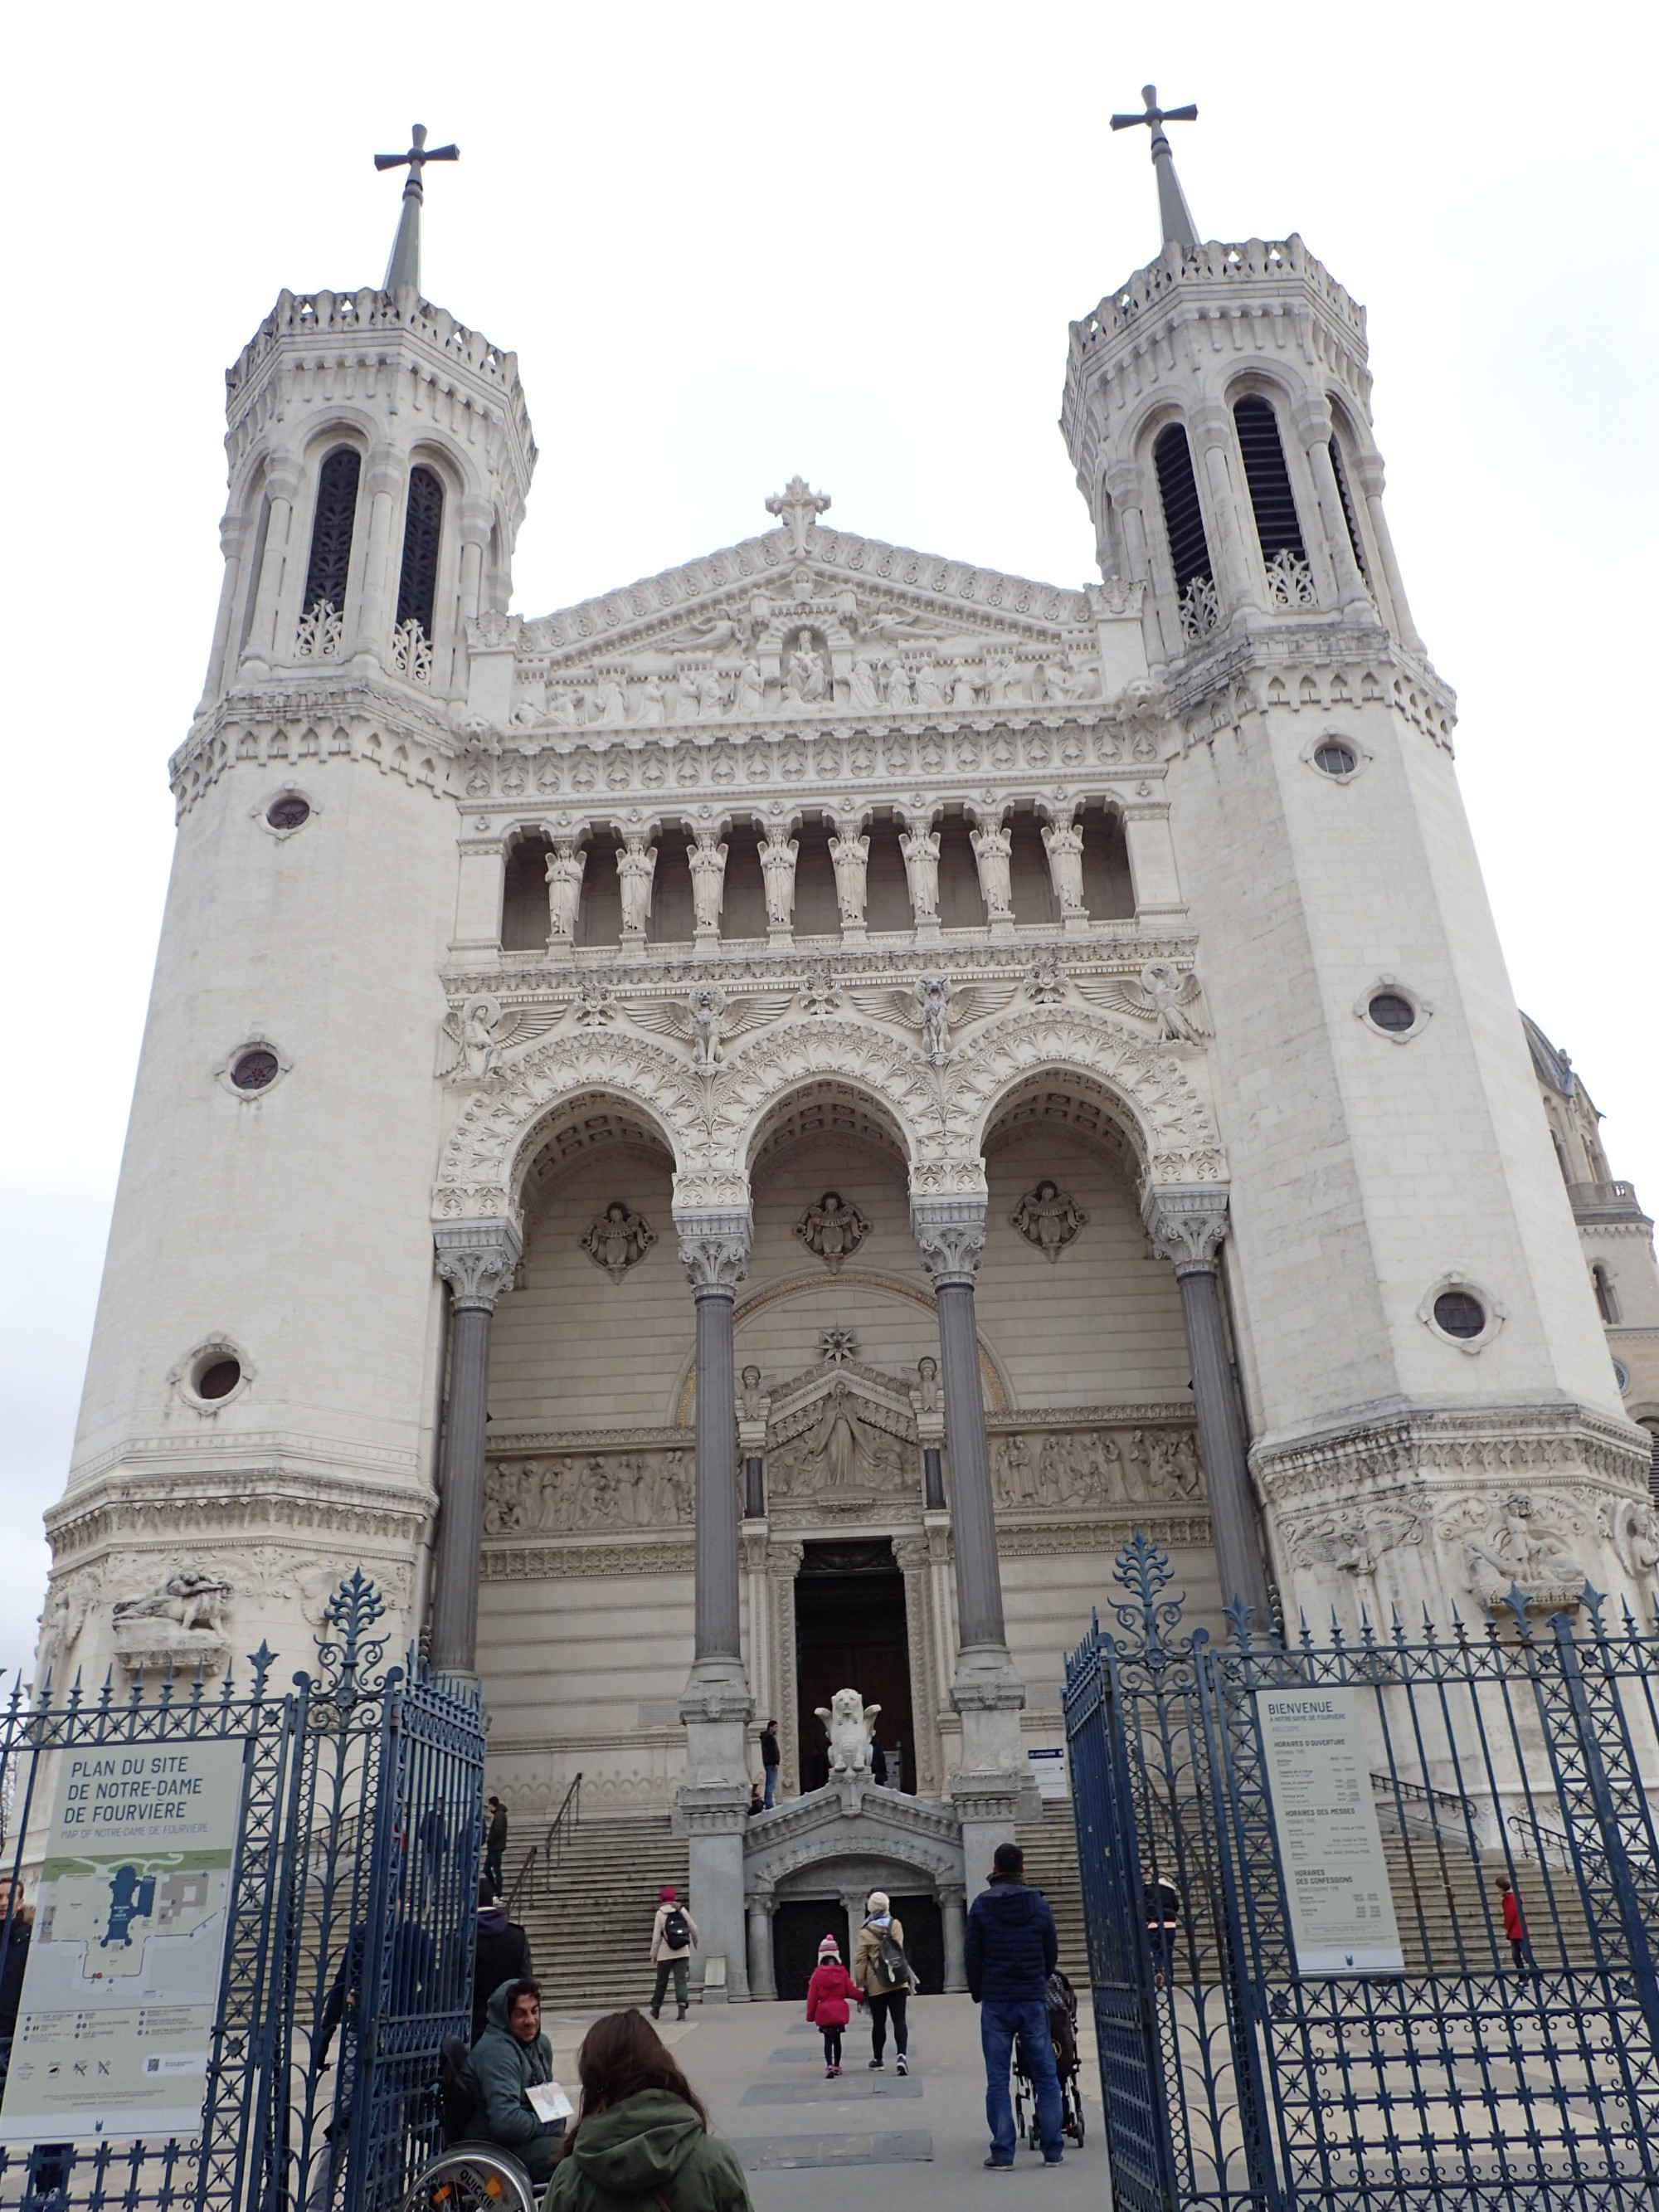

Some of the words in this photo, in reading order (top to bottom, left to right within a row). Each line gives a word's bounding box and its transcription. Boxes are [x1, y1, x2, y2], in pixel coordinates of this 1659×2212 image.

[1268, 1702, 1333, 1714] BIENVENUE
[71, 1760, 115, 1777] PLAN
[122, 1759, 144, 1775] DU
[151, 1756, 188, 1773] SITE
[67, 1784, 90, 1800] DE
[96, 1778, 203, 1799] NOTRE-DAME
[64, 1807, 86, 1824] DE
[92, 1799, 187, 1822] FOURVIÈRE
[61, 1830, 78, 1839] MAP
[80, 1830, 91, 1839] OF
[149, 1825, 160, 1834] DE
[460, 2169, 495, 2208] QUICKIE
